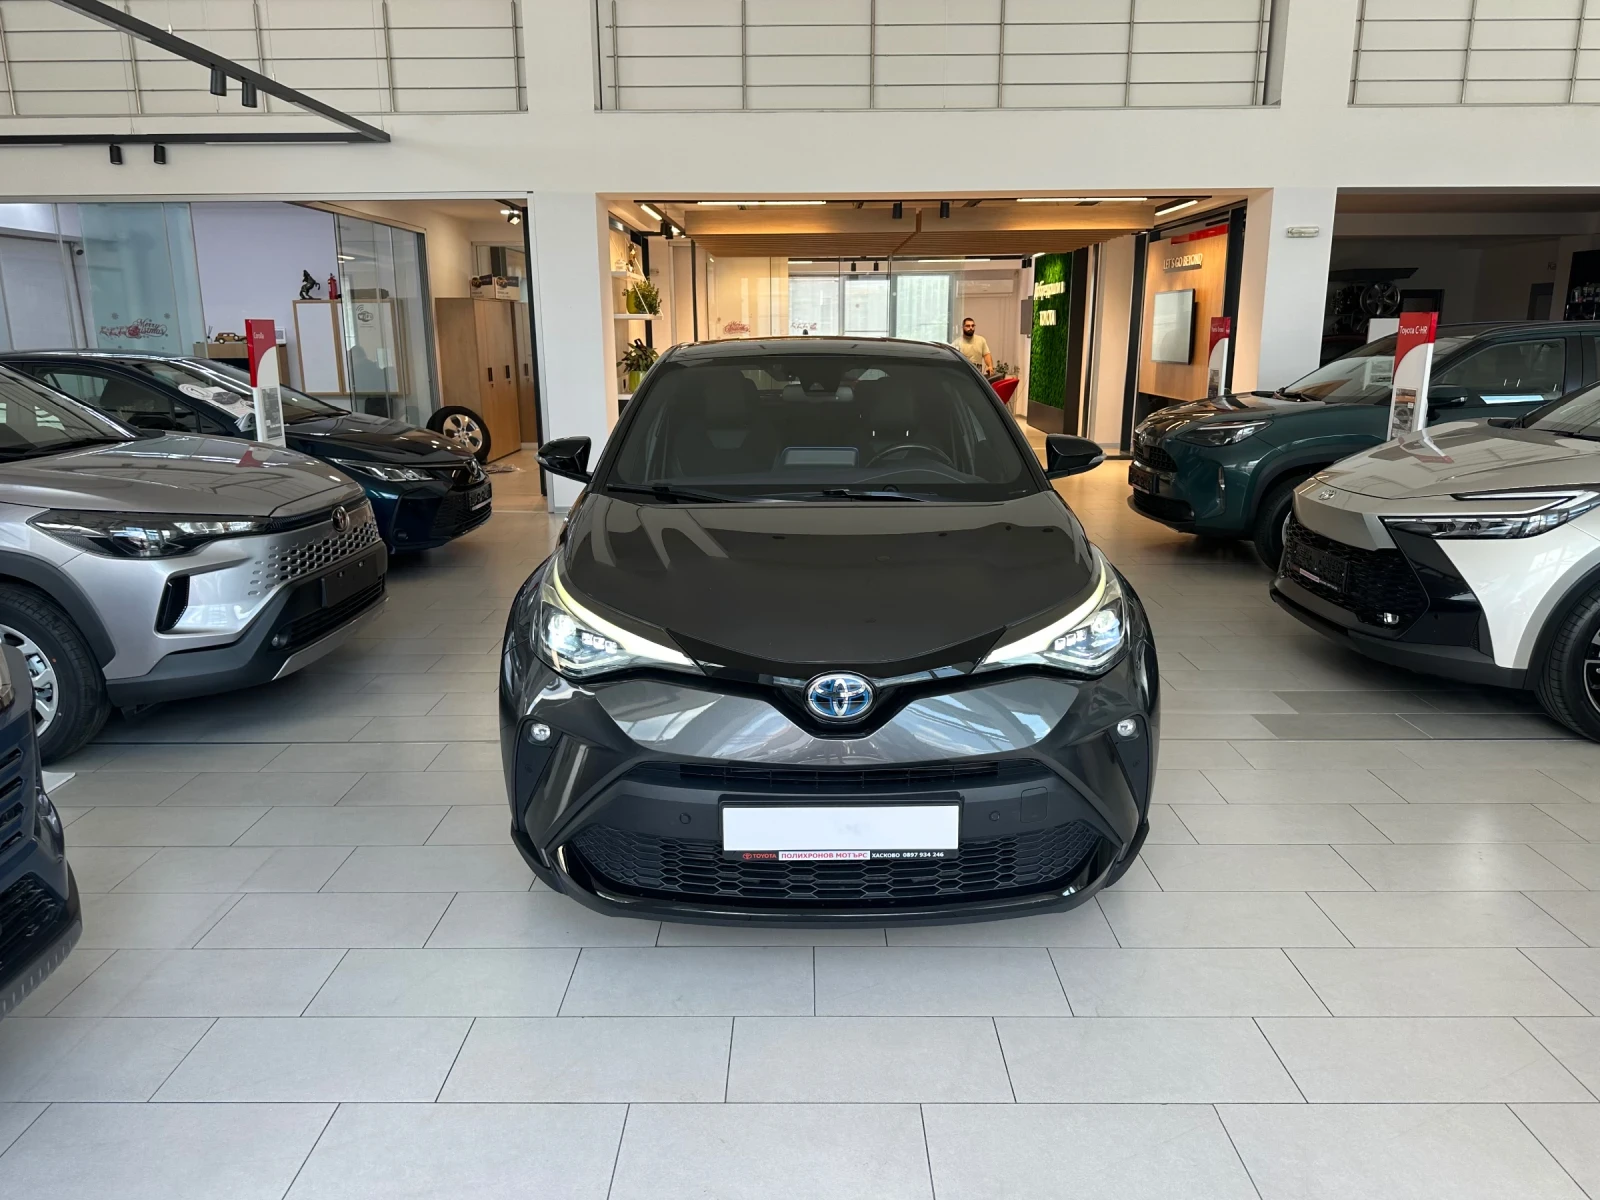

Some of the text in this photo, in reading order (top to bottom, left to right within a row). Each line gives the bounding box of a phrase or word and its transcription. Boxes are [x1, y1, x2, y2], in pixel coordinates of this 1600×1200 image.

[1175, 256, 1183, 268] GO
[1400, 325, 1428, 336] Toyota C-HR
